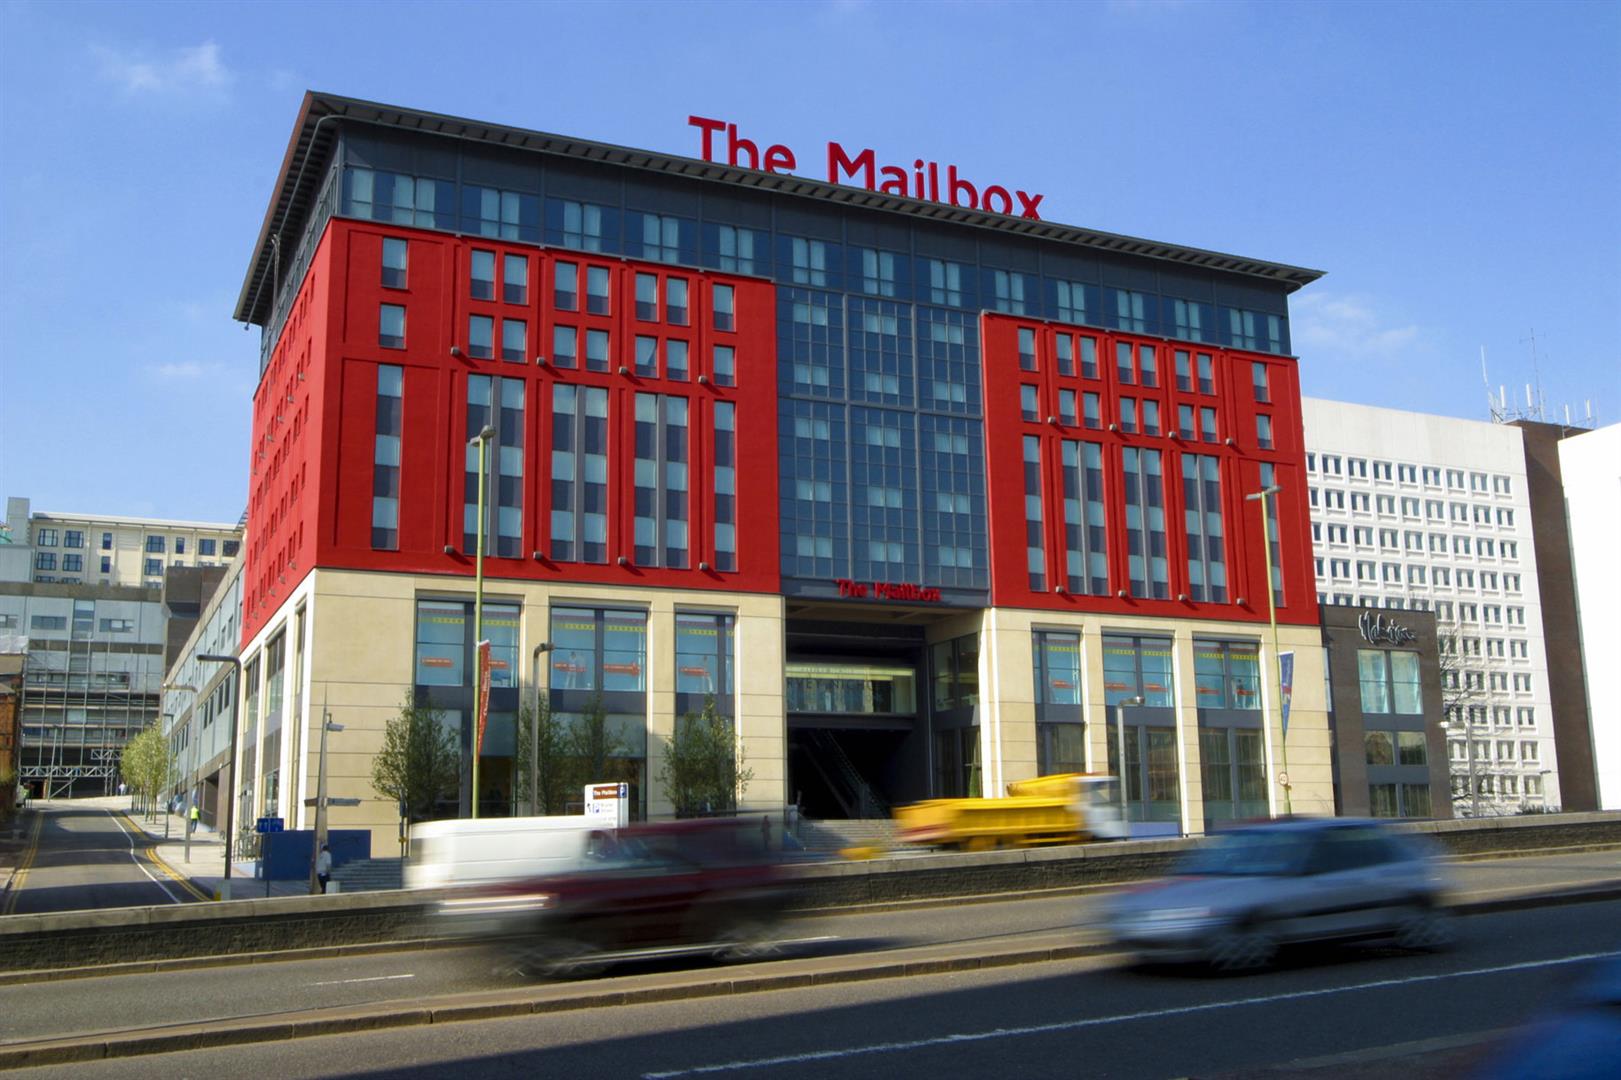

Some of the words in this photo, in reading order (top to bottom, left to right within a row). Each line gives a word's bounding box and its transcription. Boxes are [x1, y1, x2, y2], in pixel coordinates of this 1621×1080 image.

[688, 115, 796, 176] The
[828, 141, 1044, 221] Mailbox
[833, 578, 868, 598] The
